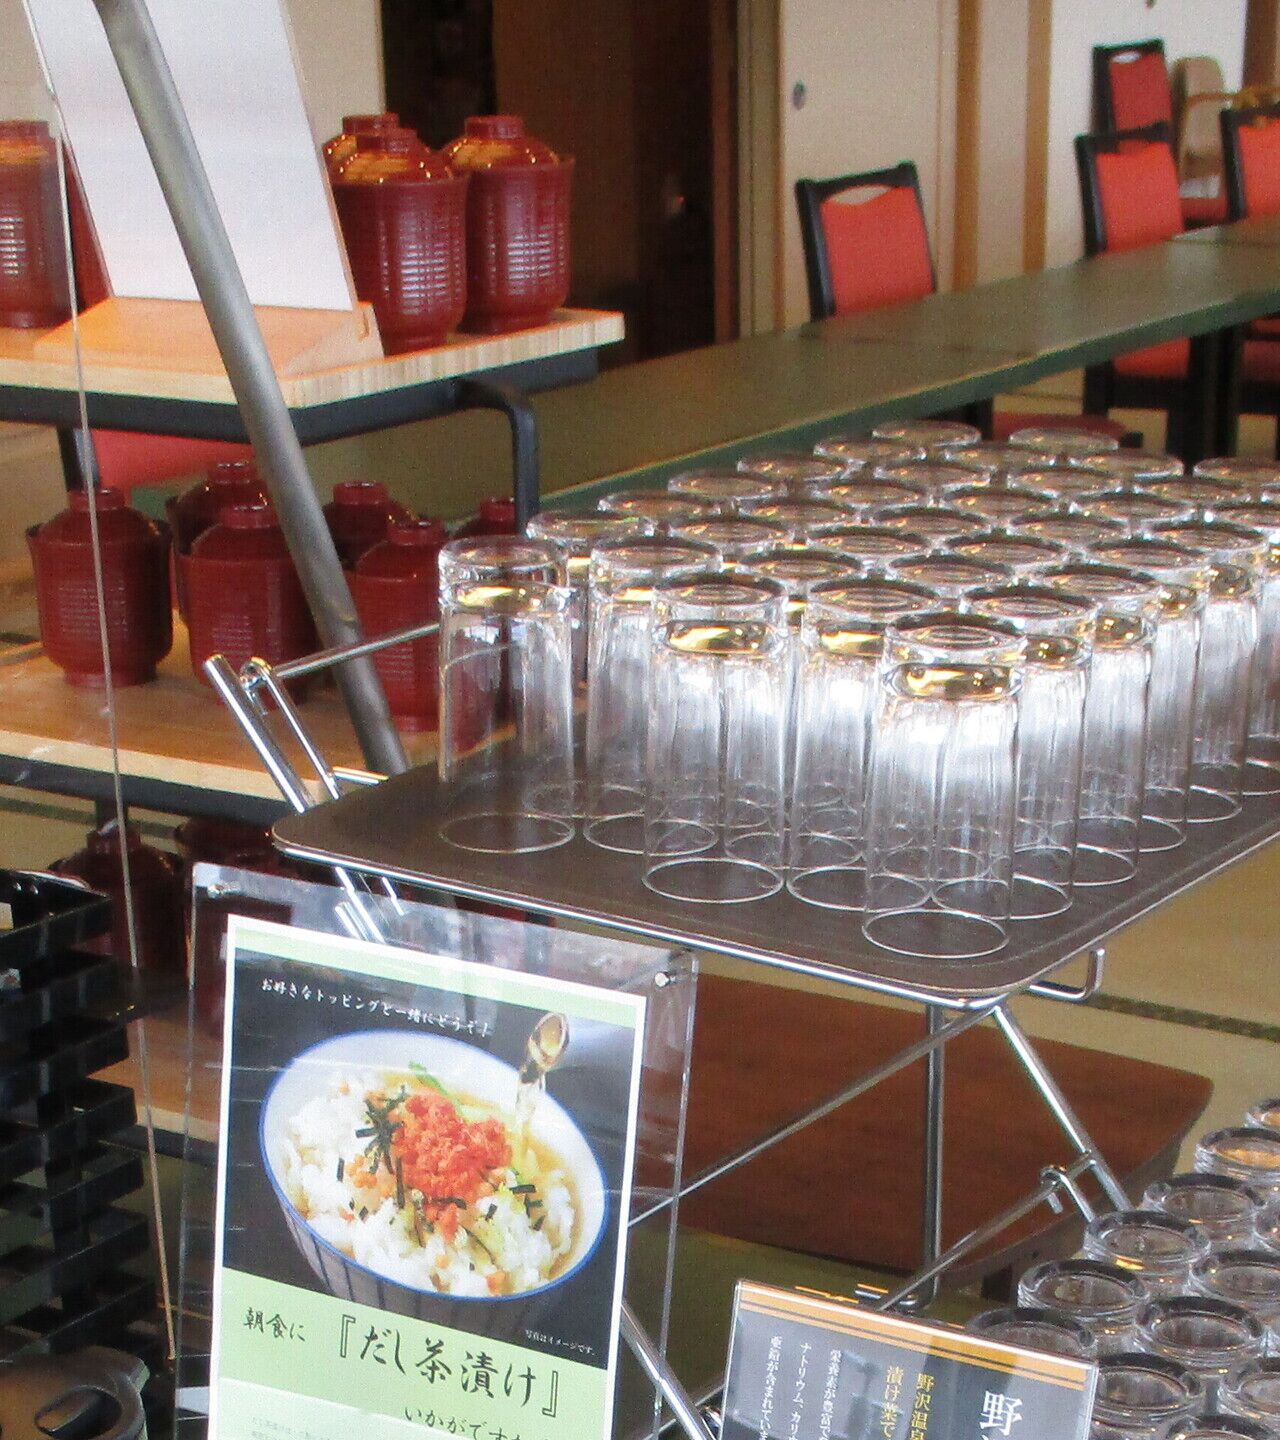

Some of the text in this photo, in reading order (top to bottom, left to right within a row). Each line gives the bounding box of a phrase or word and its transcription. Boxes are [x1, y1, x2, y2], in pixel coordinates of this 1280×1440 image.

[242, 1307, 307, 1343] 朝食に
[339, 1314, 560, 1418] 『だし茶漬け』
